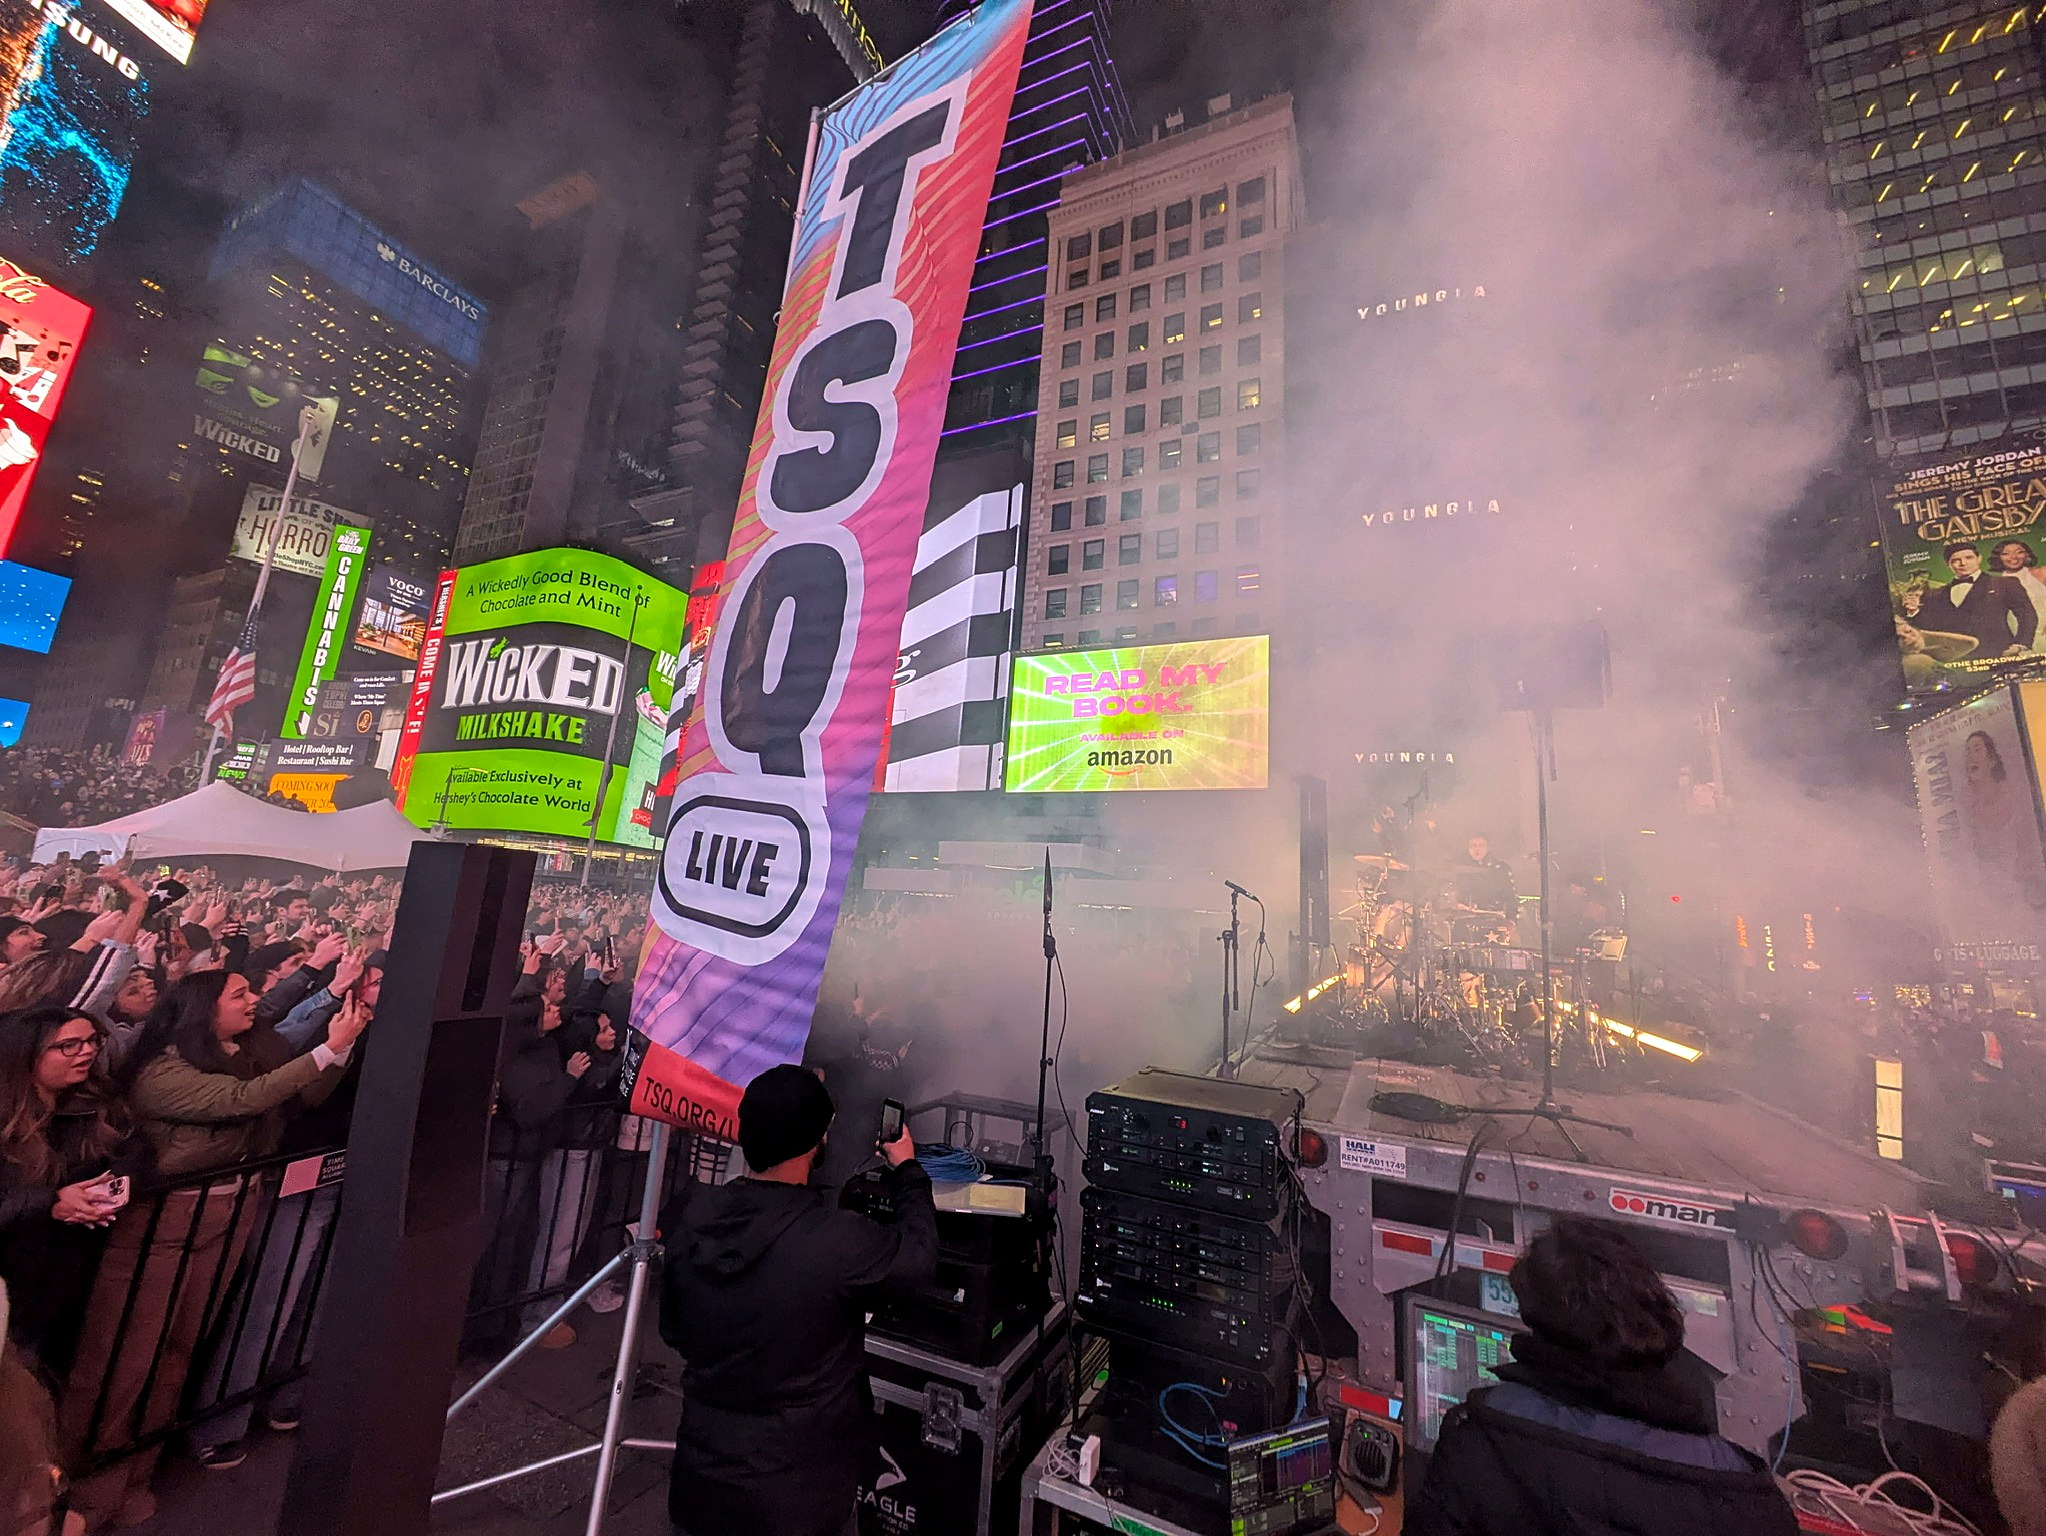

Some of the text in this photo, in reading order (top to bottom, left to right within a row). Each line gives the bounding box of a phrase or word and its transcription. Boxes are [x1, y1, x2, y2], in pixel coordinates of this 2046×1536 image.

[31, 0, 140, 81] SUNG
[398, 258, 479, 320] BARCLAYS
[1973, 446, 2042, 468] JORDAN
[1893, 474, 1942, 493] SINGS
[1944, 469, 1972, 483] HIS
[1975, 460, 2017, 477] FACE
[1897, 477, 2046, 525] THE GREA
[1917, 499, 2046, 542] GATSBY
[1952, 534, 1979, 545] NEW
[1980, 526, 2032, 541] MUSICAL
[466, 570, 651, 609] A Wickedly Good Blend of
[480, 590, 621, 618] Chocolate and Mint
[303, 556, 352, 707] CANNABIS
[418, 638, 441, 679] COME
[1972, 653, 2028, 667] BROADWAY
[1045, 662, 1228, 695] READ MY
[1073, 691, 1193, 718] BOOK.
[455, 710, 587, 745] MILKSHAKE
[1080, 729, 1185, 742] AVAILABLE ON
[277, 756, 353, 766] Restaurant Sushi Bar
[284, 744, 349, 756] Hotel Rooftop Bar
[1087, 748, 1172, 766] amazon
[217, 768, 246, 780] NEWS
[275, 780, 312, 792] COMING
[488, 769, 563, 791] Exclusively
[566, 776, 582, 791] at
[478, 790, 539, 806] Chocolate
[543, 794, 591, 813] World
[685, 830, 780, 898] LIVE
[1346, 1140, 1376, 1152] HALE
